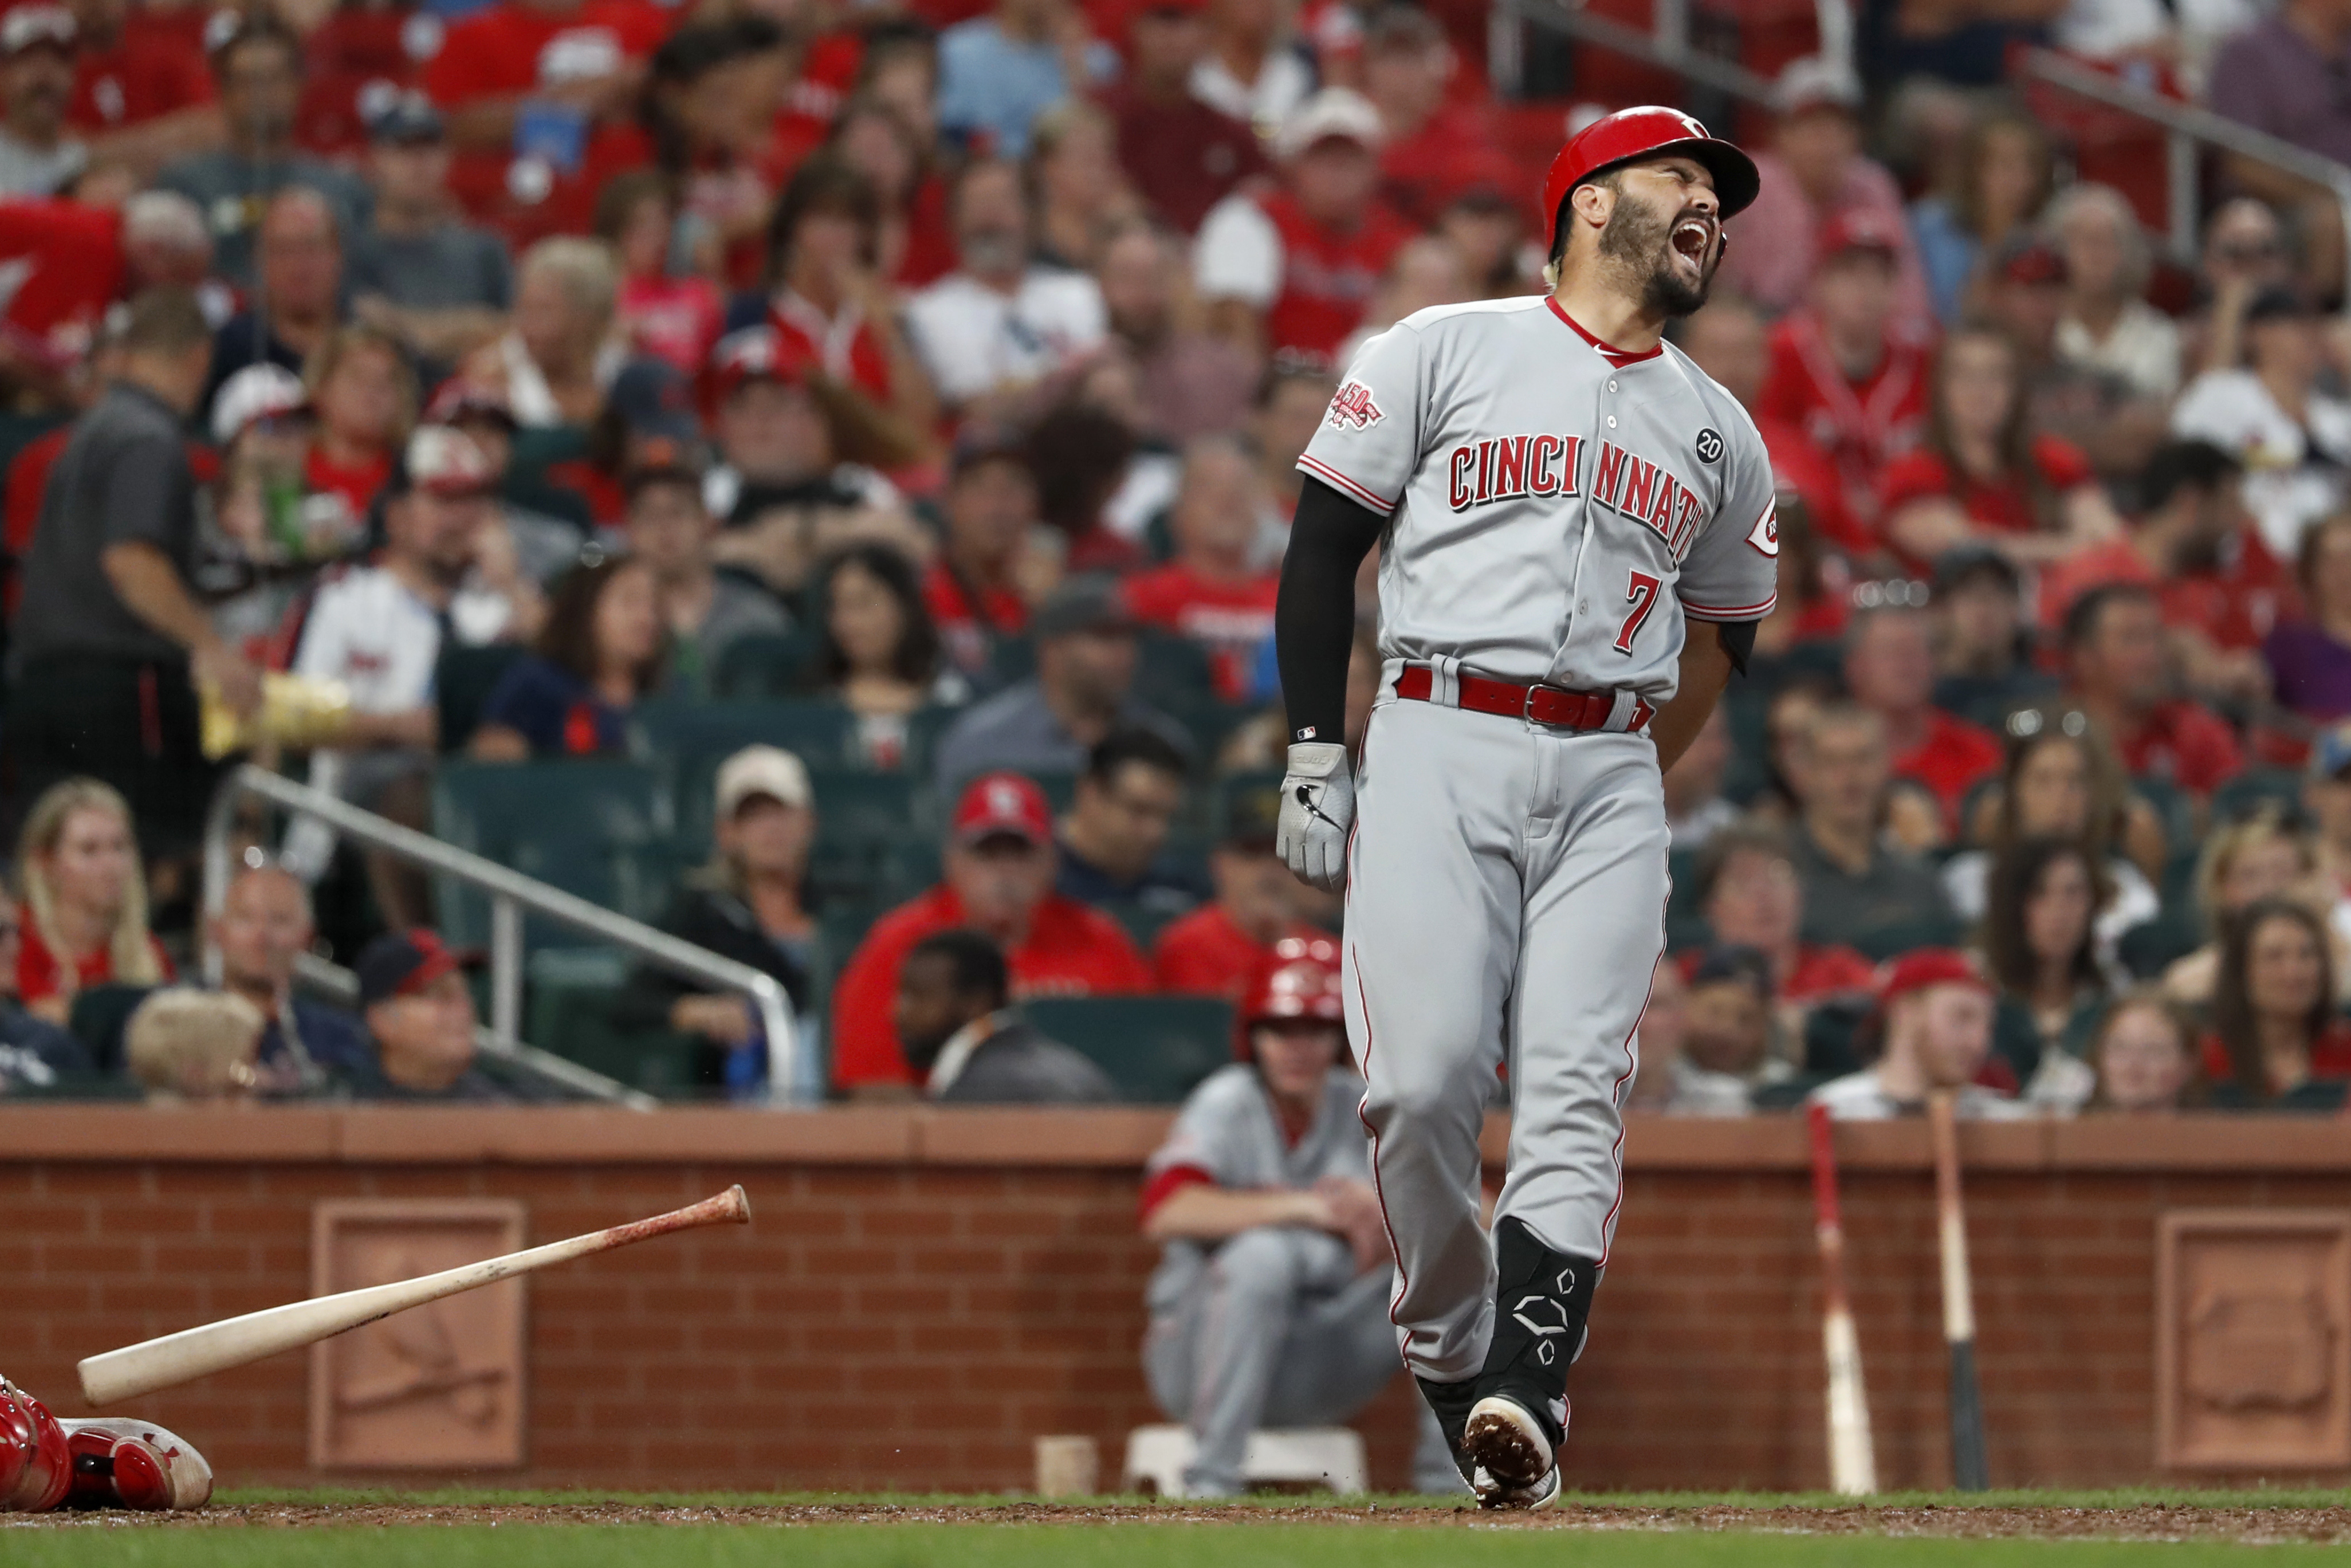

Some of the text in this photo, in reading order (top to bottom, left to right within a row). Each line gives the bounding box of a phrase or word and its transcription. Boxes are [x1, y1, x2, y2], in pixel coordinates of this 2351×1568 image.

[1340, 382, 1370, 412] 150
[1697, 432, 1721, 459] 20
[1613, 567, 1662, 657] 7
